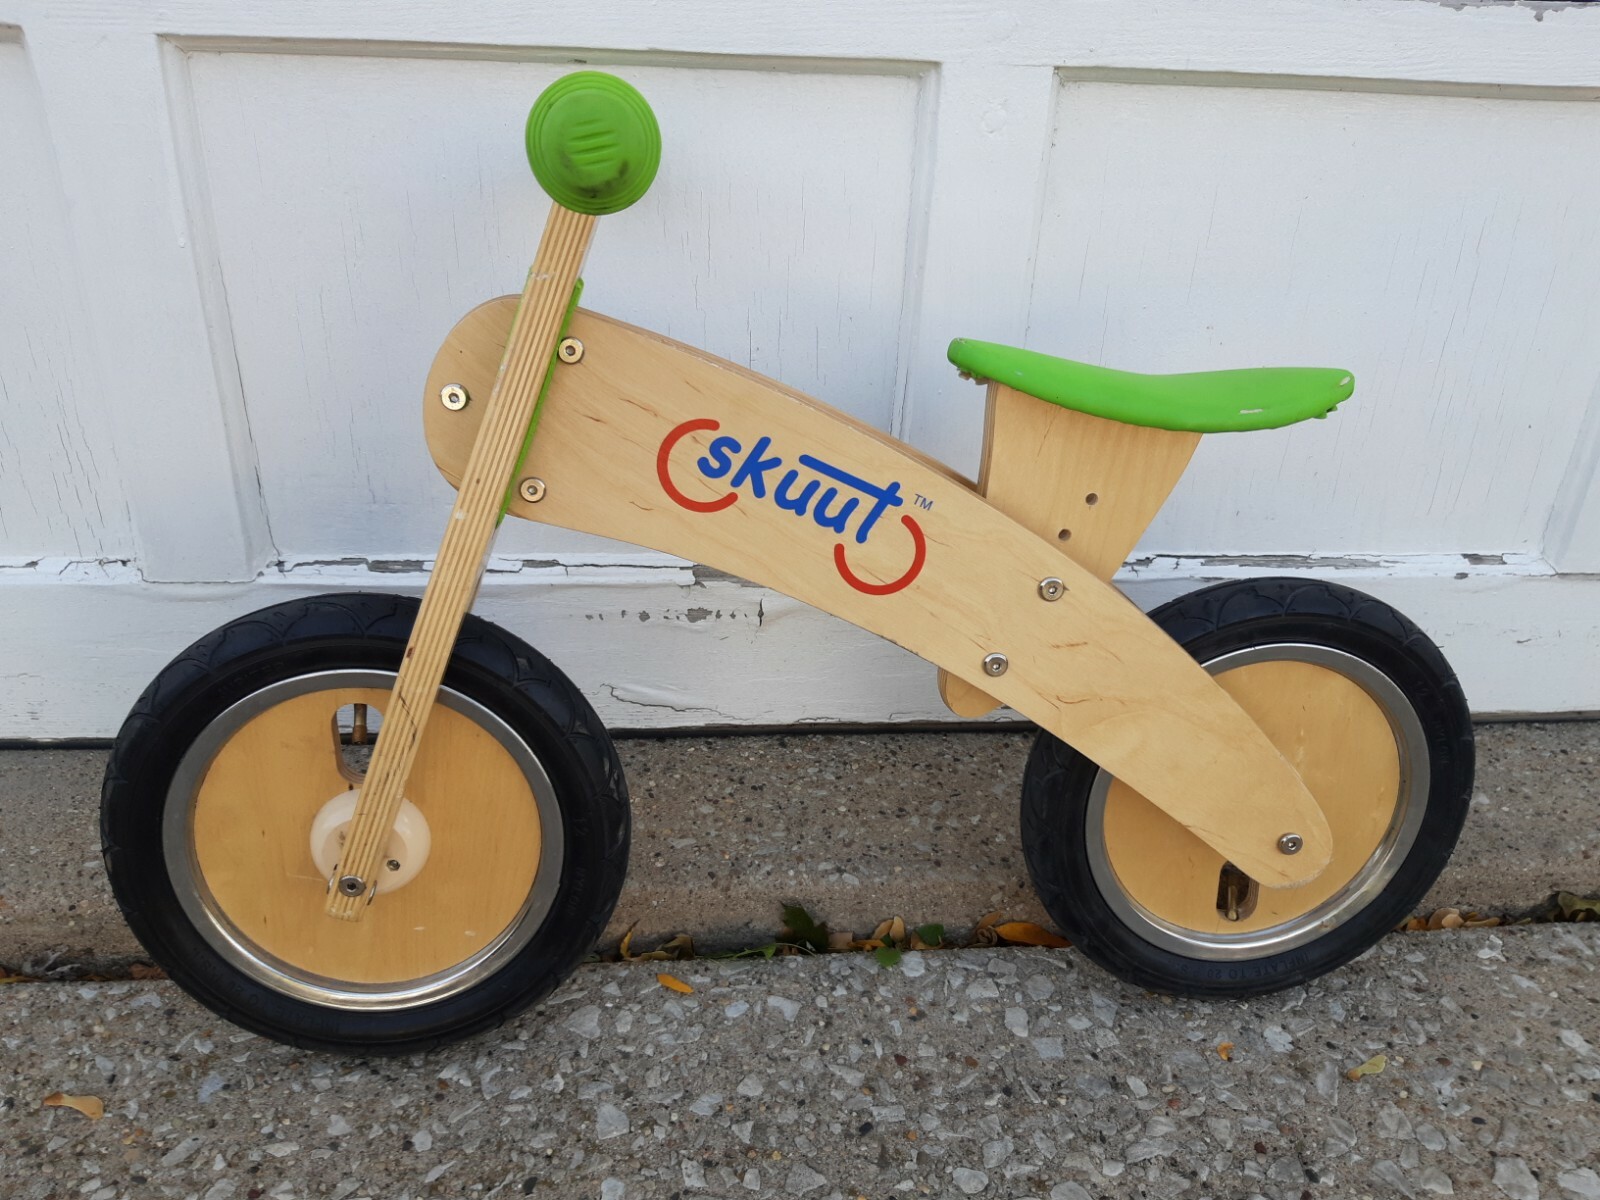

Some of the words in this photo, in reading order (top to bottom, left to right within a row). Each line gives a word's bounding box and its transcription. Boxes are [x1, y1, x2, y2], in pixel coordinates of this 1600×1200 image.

[697, 436, 903, 543] skuut
[914, 493, 933, 511] TM
[1206, 967, 1222, 979] 20
[1228, 967, 1247, 979] TO
[1255, 952, 1311, 977] INFLATE
